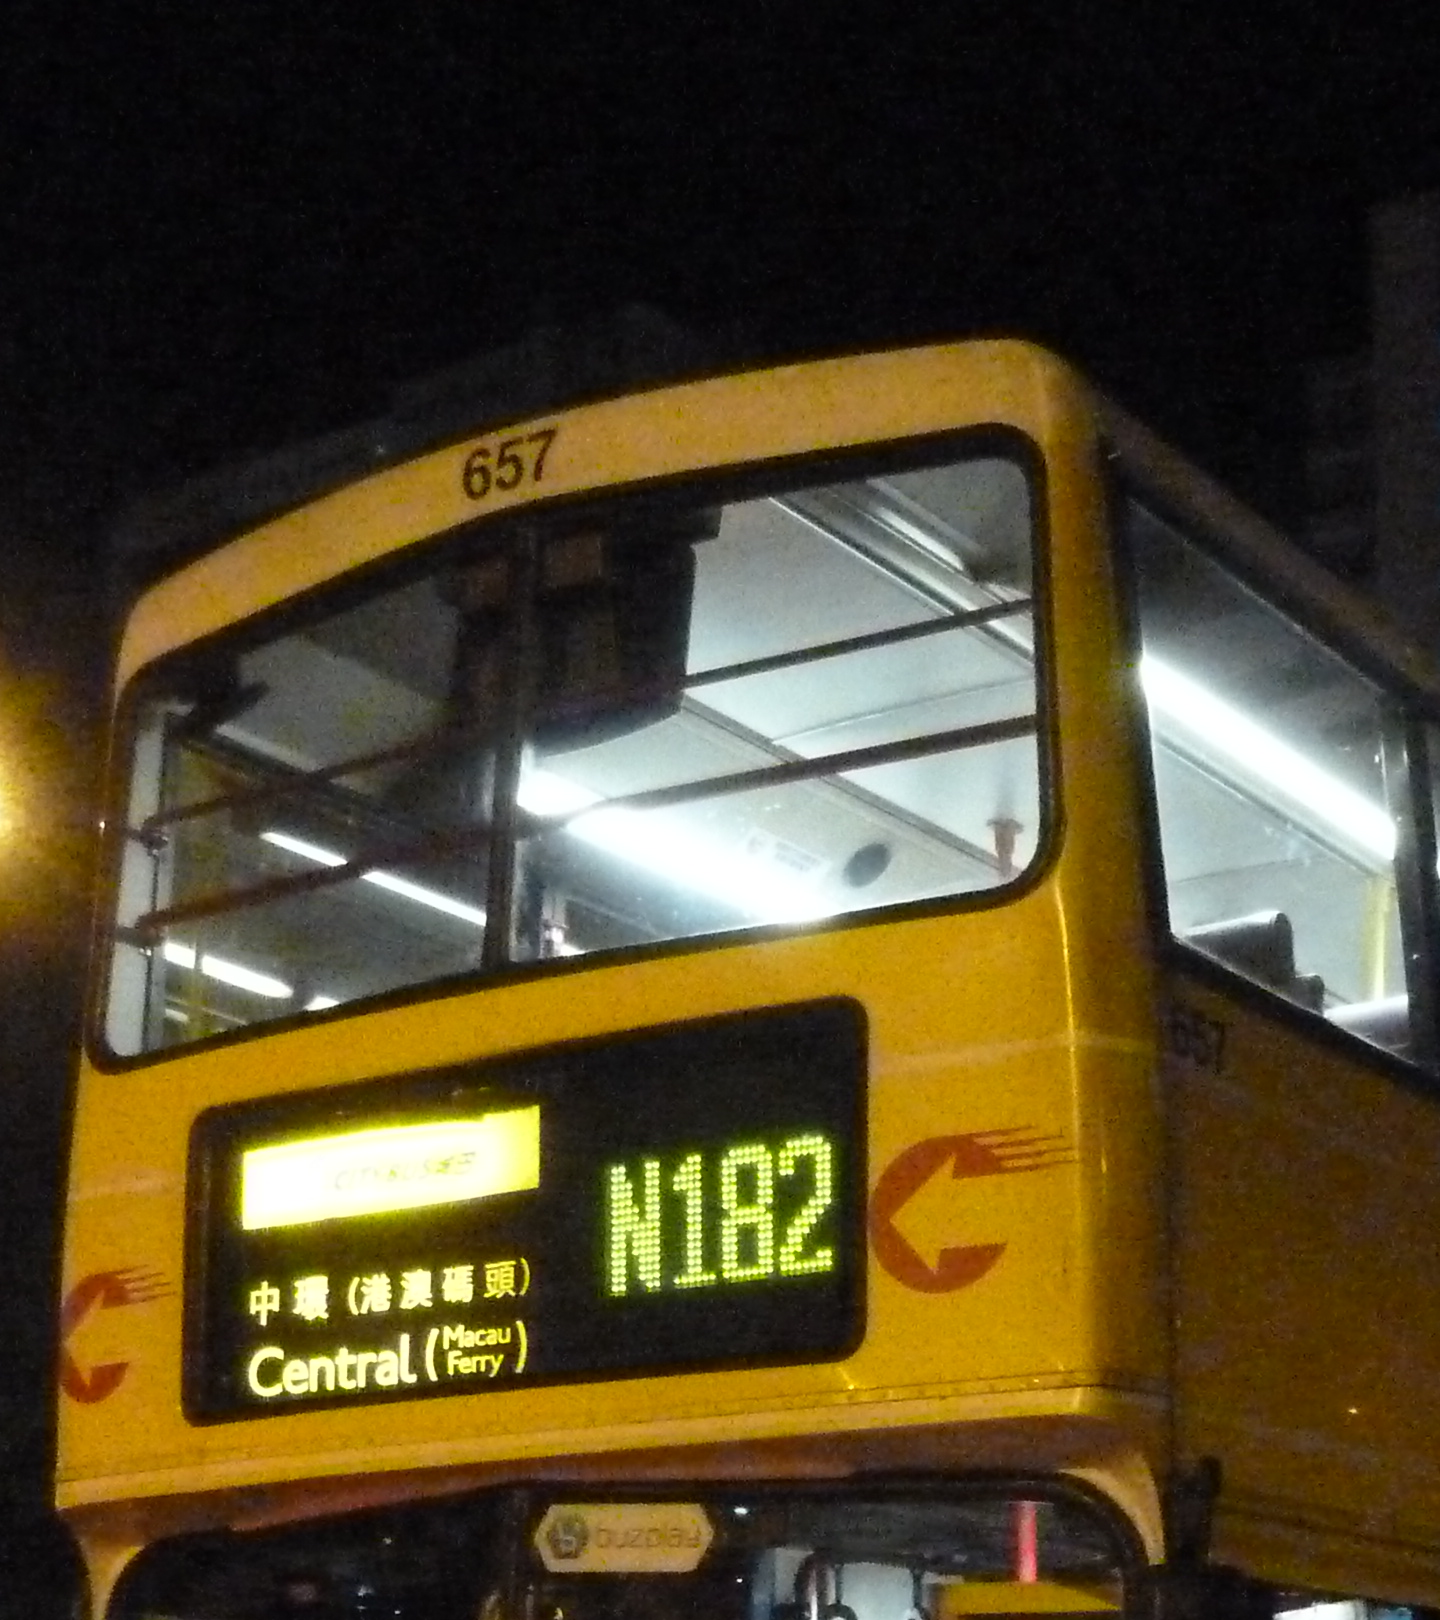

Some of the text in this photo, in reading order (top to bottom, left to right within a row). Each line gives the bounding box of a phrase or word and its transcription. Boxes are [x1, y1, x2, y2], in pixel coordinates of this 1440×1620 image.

[462, 428, 558, 500] 657
[610, 1135, 833, 1297] N182
[248, 1333, 417, 1397] Central
